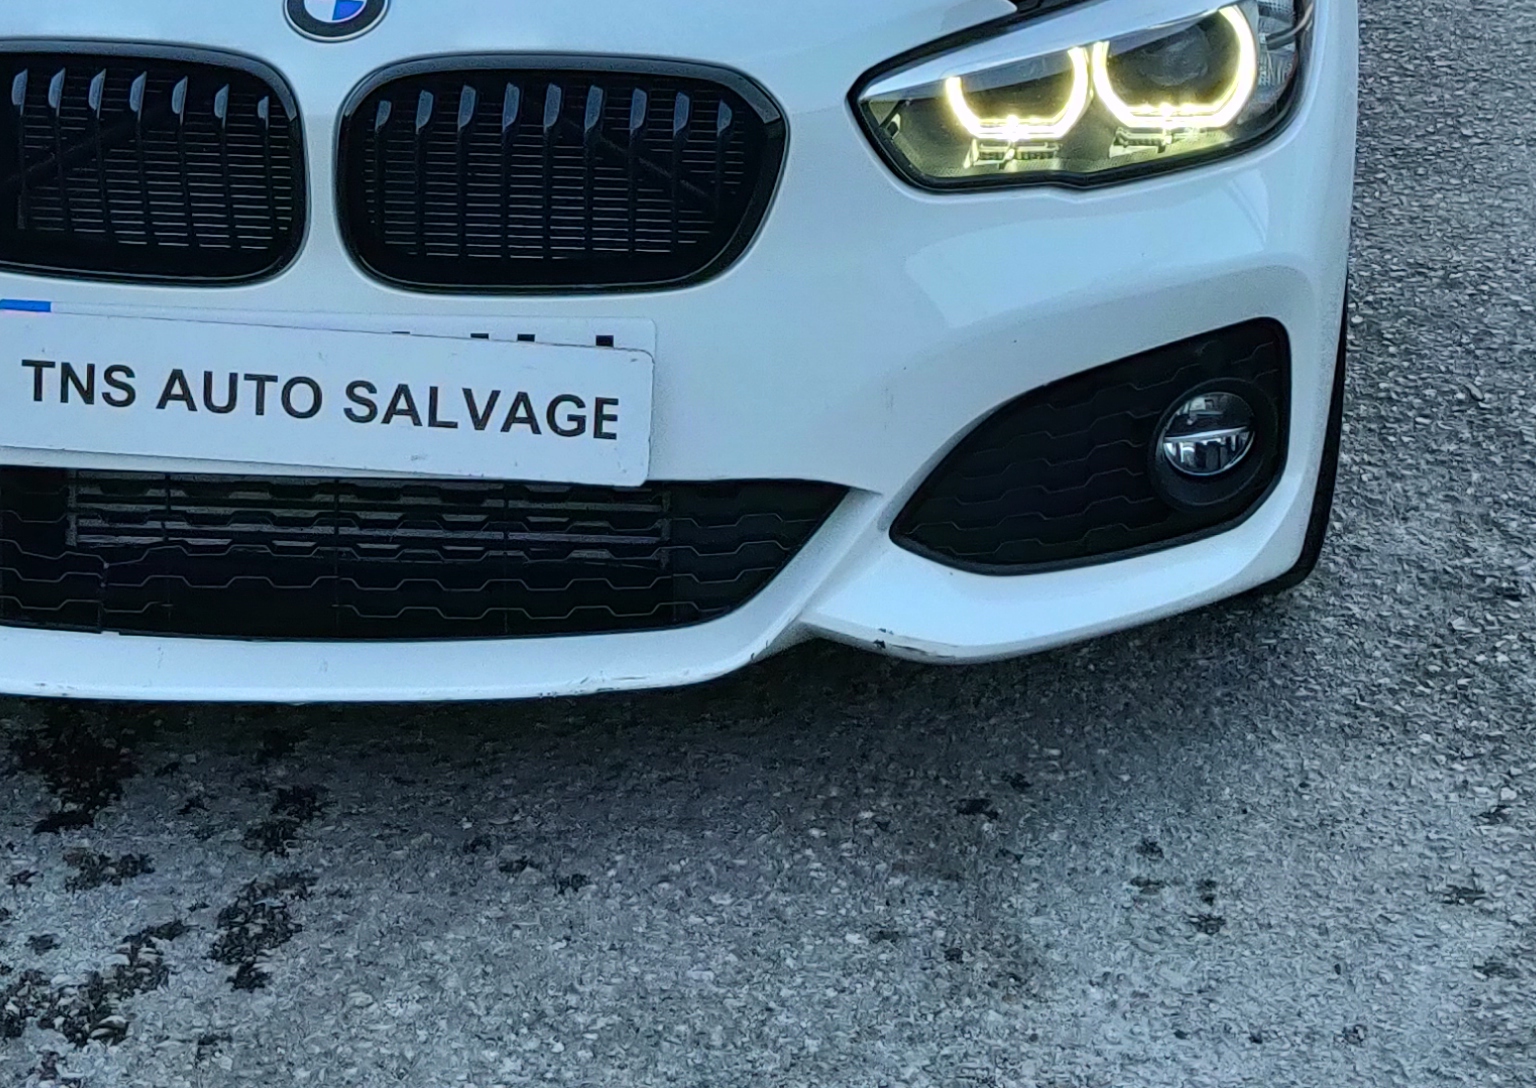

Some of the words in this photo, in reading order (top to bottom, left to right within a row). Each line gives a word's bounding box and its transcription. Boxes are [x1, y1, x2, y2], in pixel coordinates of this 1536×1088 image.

[20, 358, 137, 408] TNS
[155, 368, 324, 420] AUTO
[343, 380, 620, 441] SALVAGE
